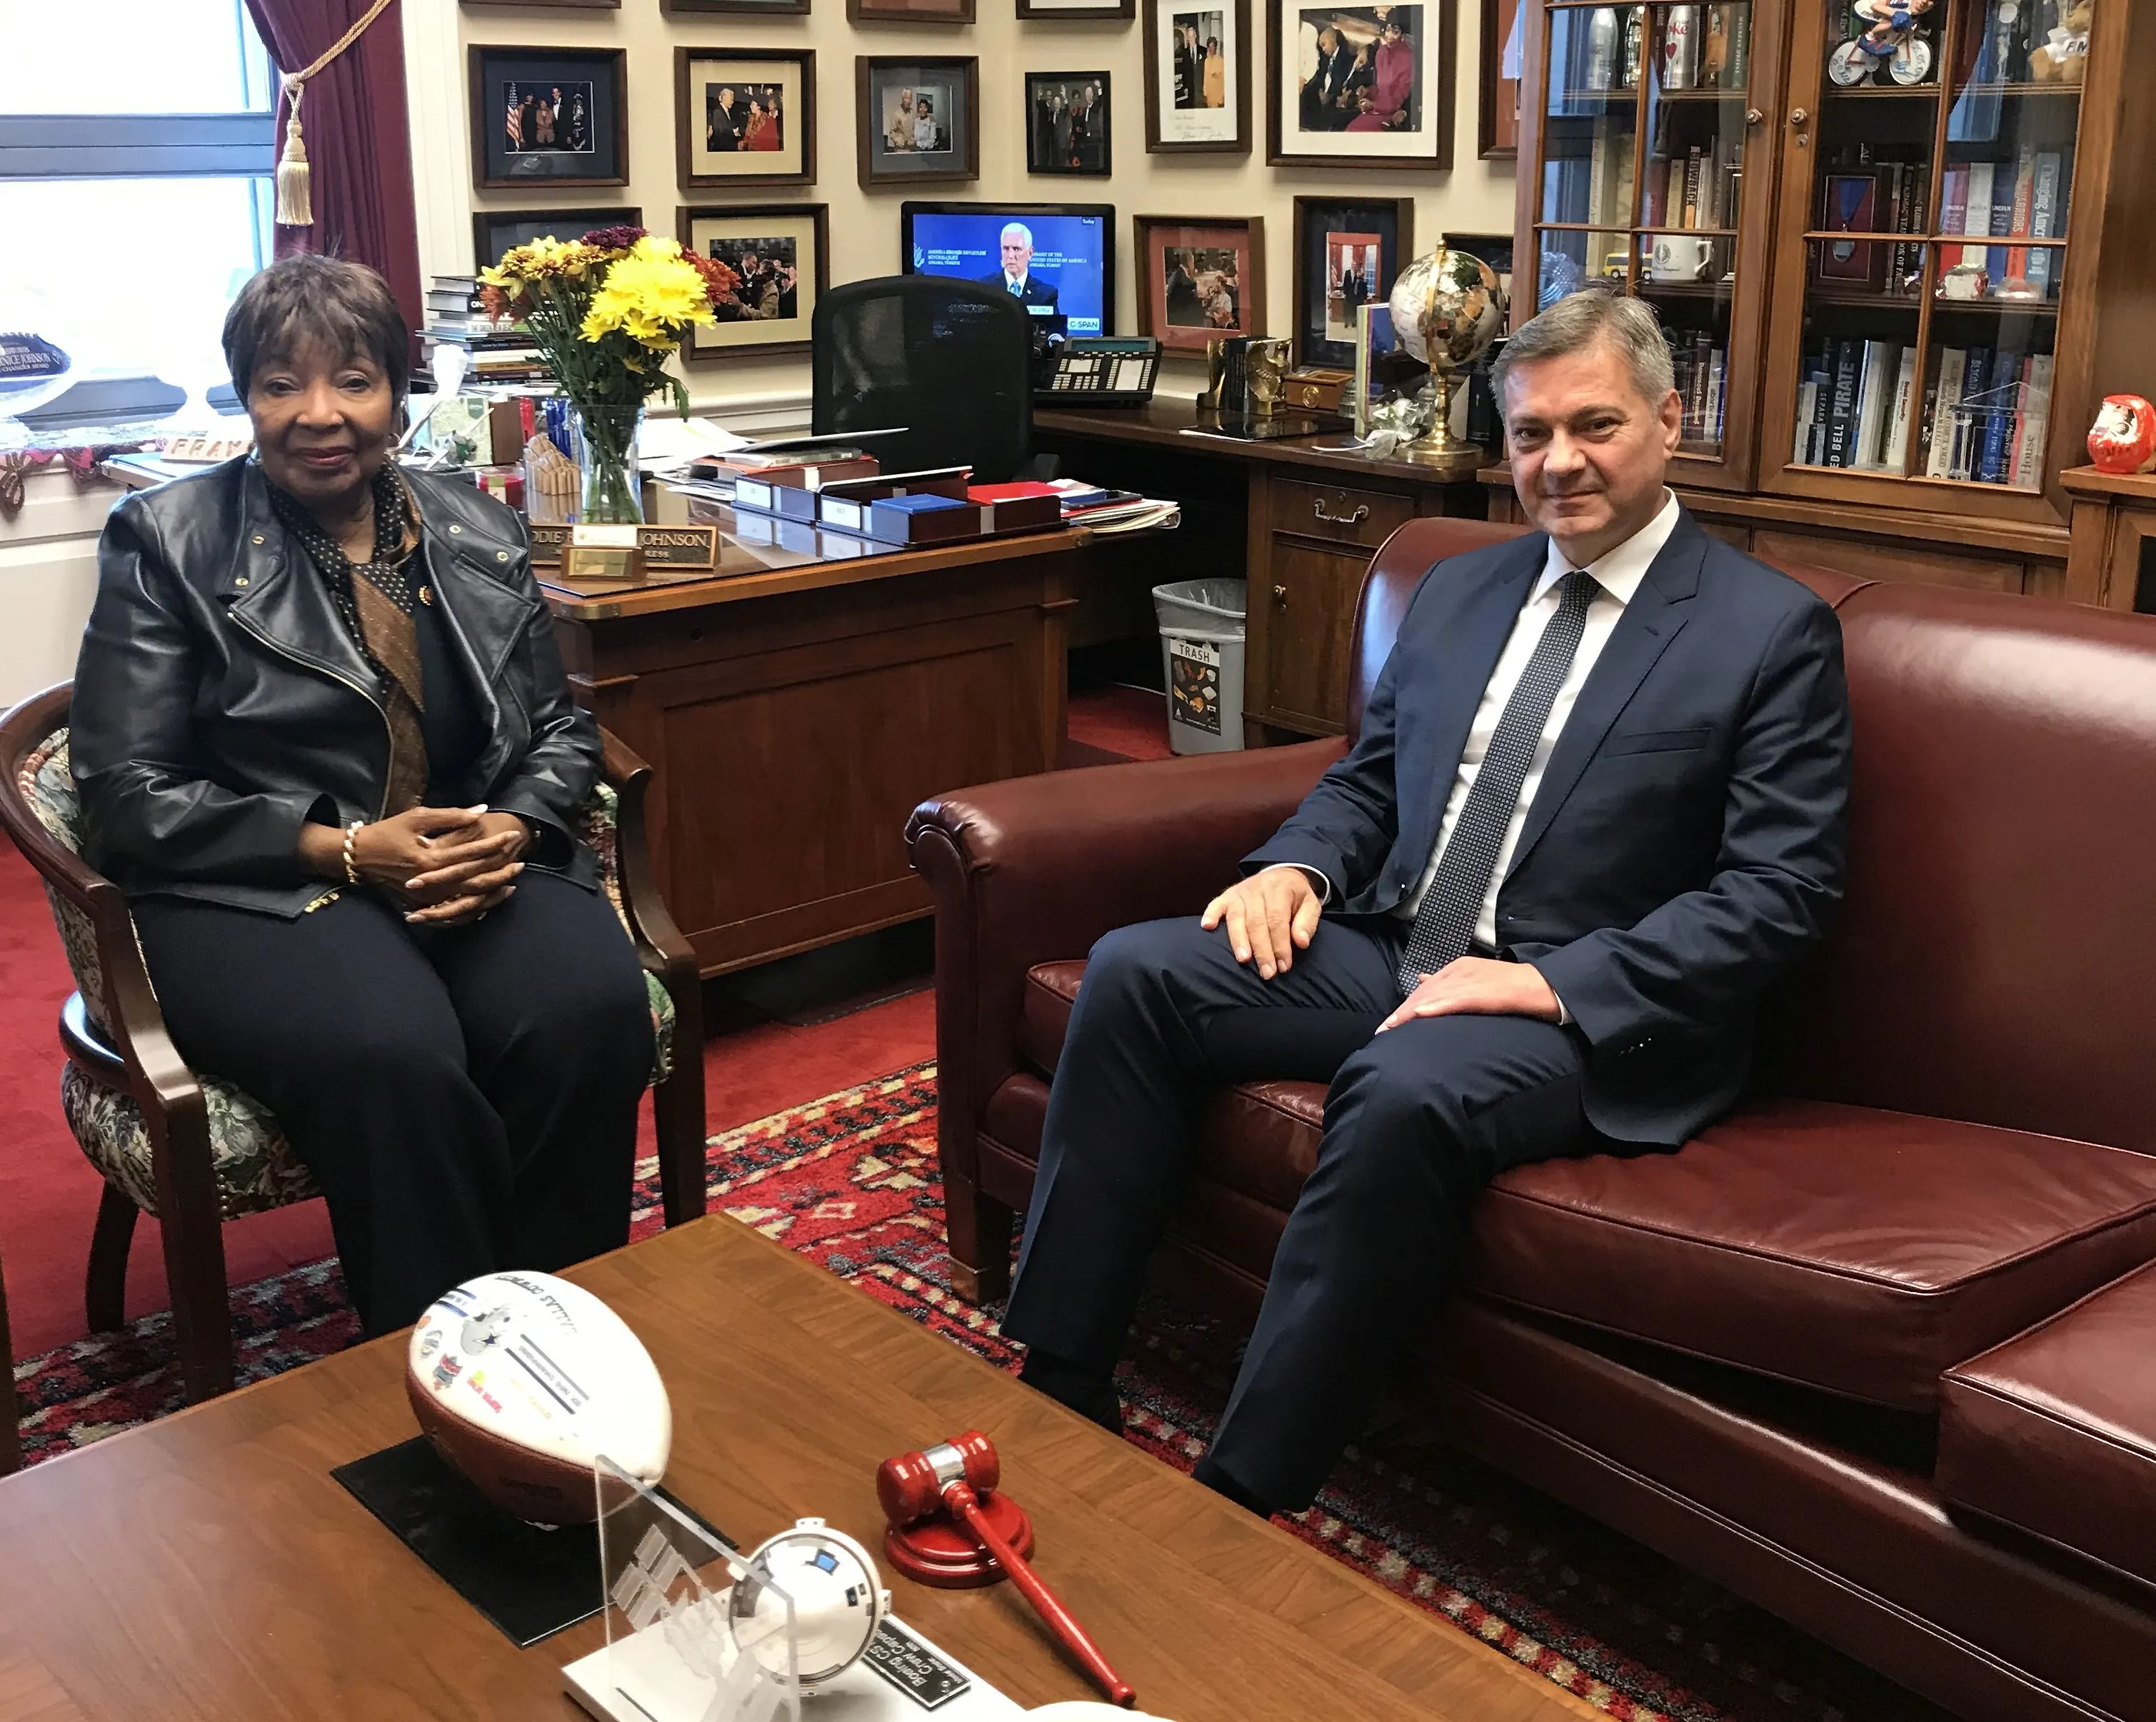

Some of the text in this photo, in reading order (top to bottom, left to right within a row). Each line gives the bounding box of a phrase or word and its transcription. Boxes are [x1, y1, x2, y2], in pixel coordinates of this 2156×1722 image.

[1833, 361, 1855, 418] PIRATE
[1832, 424, 1845, 451] BELL
[2020, 434, 2035, 475] House
[1179, 644, 1210, 663] TRASH
[888, 1656, 928, 1687] Boeing
[903, 1652, 933, 1675] Crew
